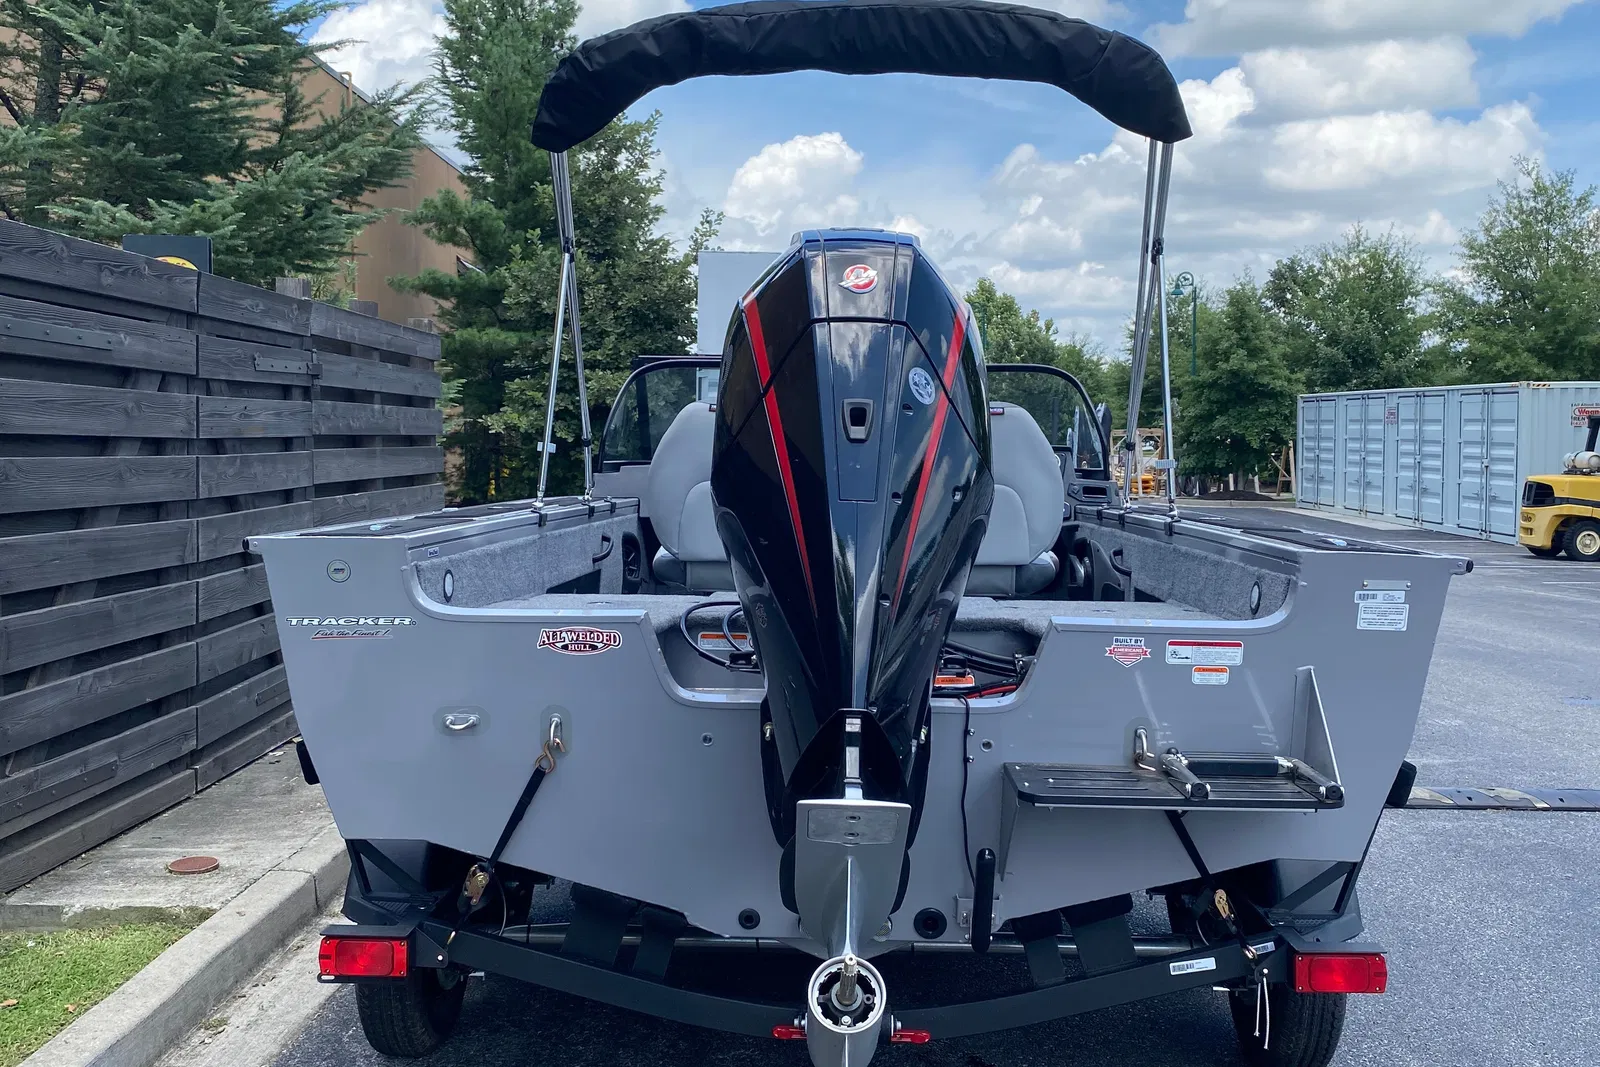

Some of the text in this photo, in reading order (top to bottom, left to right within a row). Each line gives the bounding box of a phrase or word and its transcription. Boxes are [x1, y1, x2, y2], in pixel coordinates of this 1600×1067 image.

[286, 617, 413, 627] TRACKER
[314, 629, 334, 637] Fish
[335, 629, 350, 637] the
[540, 631, 620, 646] ALL WELDED
